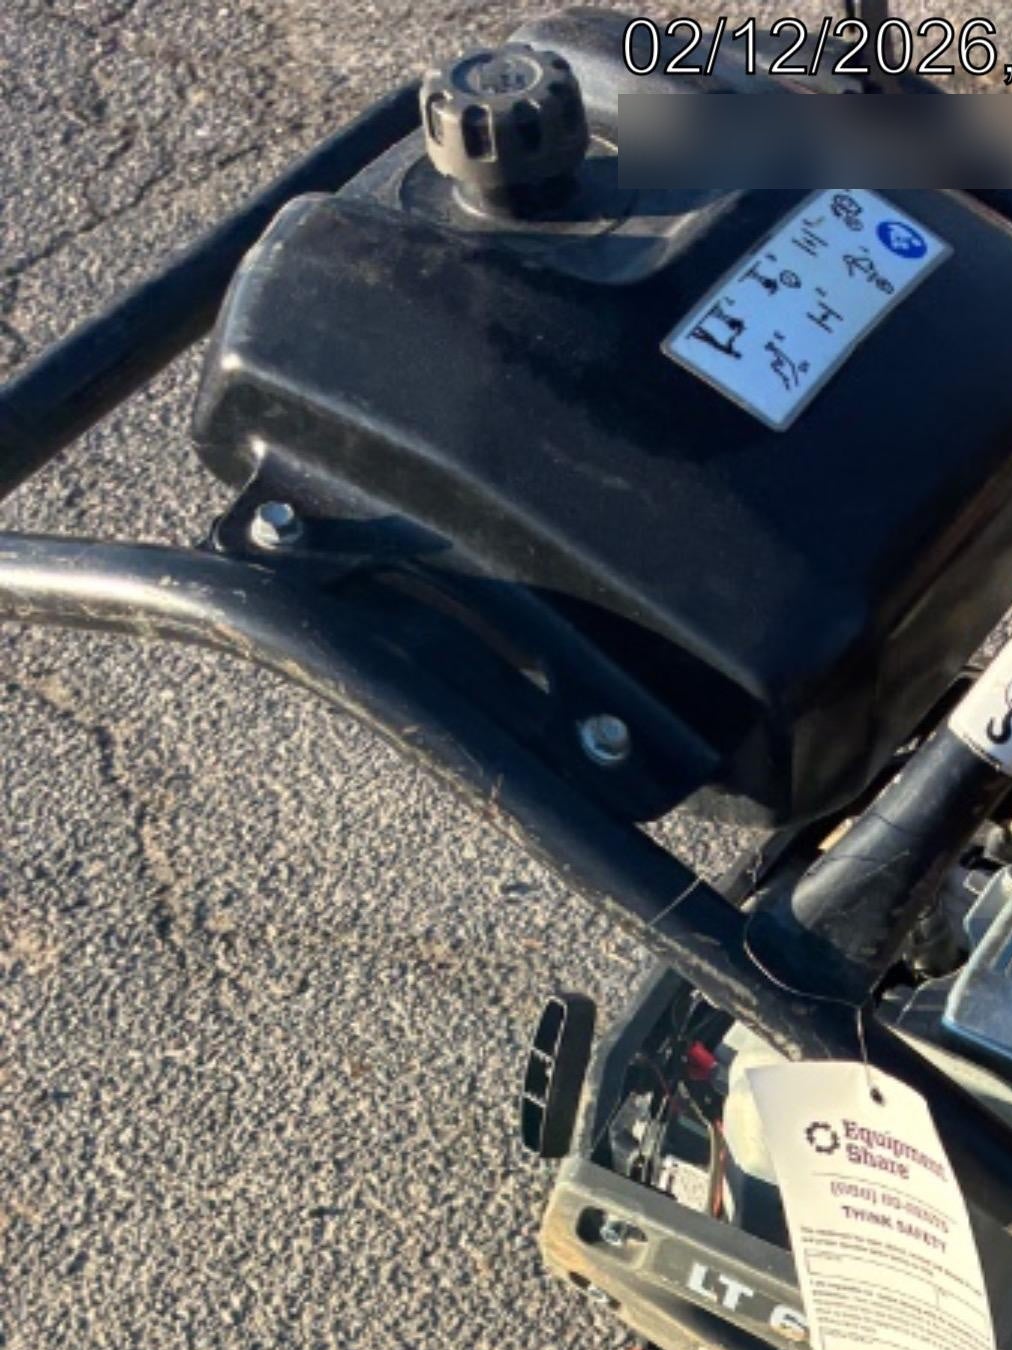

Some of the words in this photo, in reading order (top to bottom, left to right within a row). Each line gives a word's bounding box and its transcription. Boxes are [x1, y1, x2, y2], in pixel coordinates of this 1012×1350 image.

[841, 1118, 949, 1183] Equipment
[845, 1143, 910, 1180] Share
[686, 1261, 755, 1313] LT
[769, 1303, 809, 1342] 6
